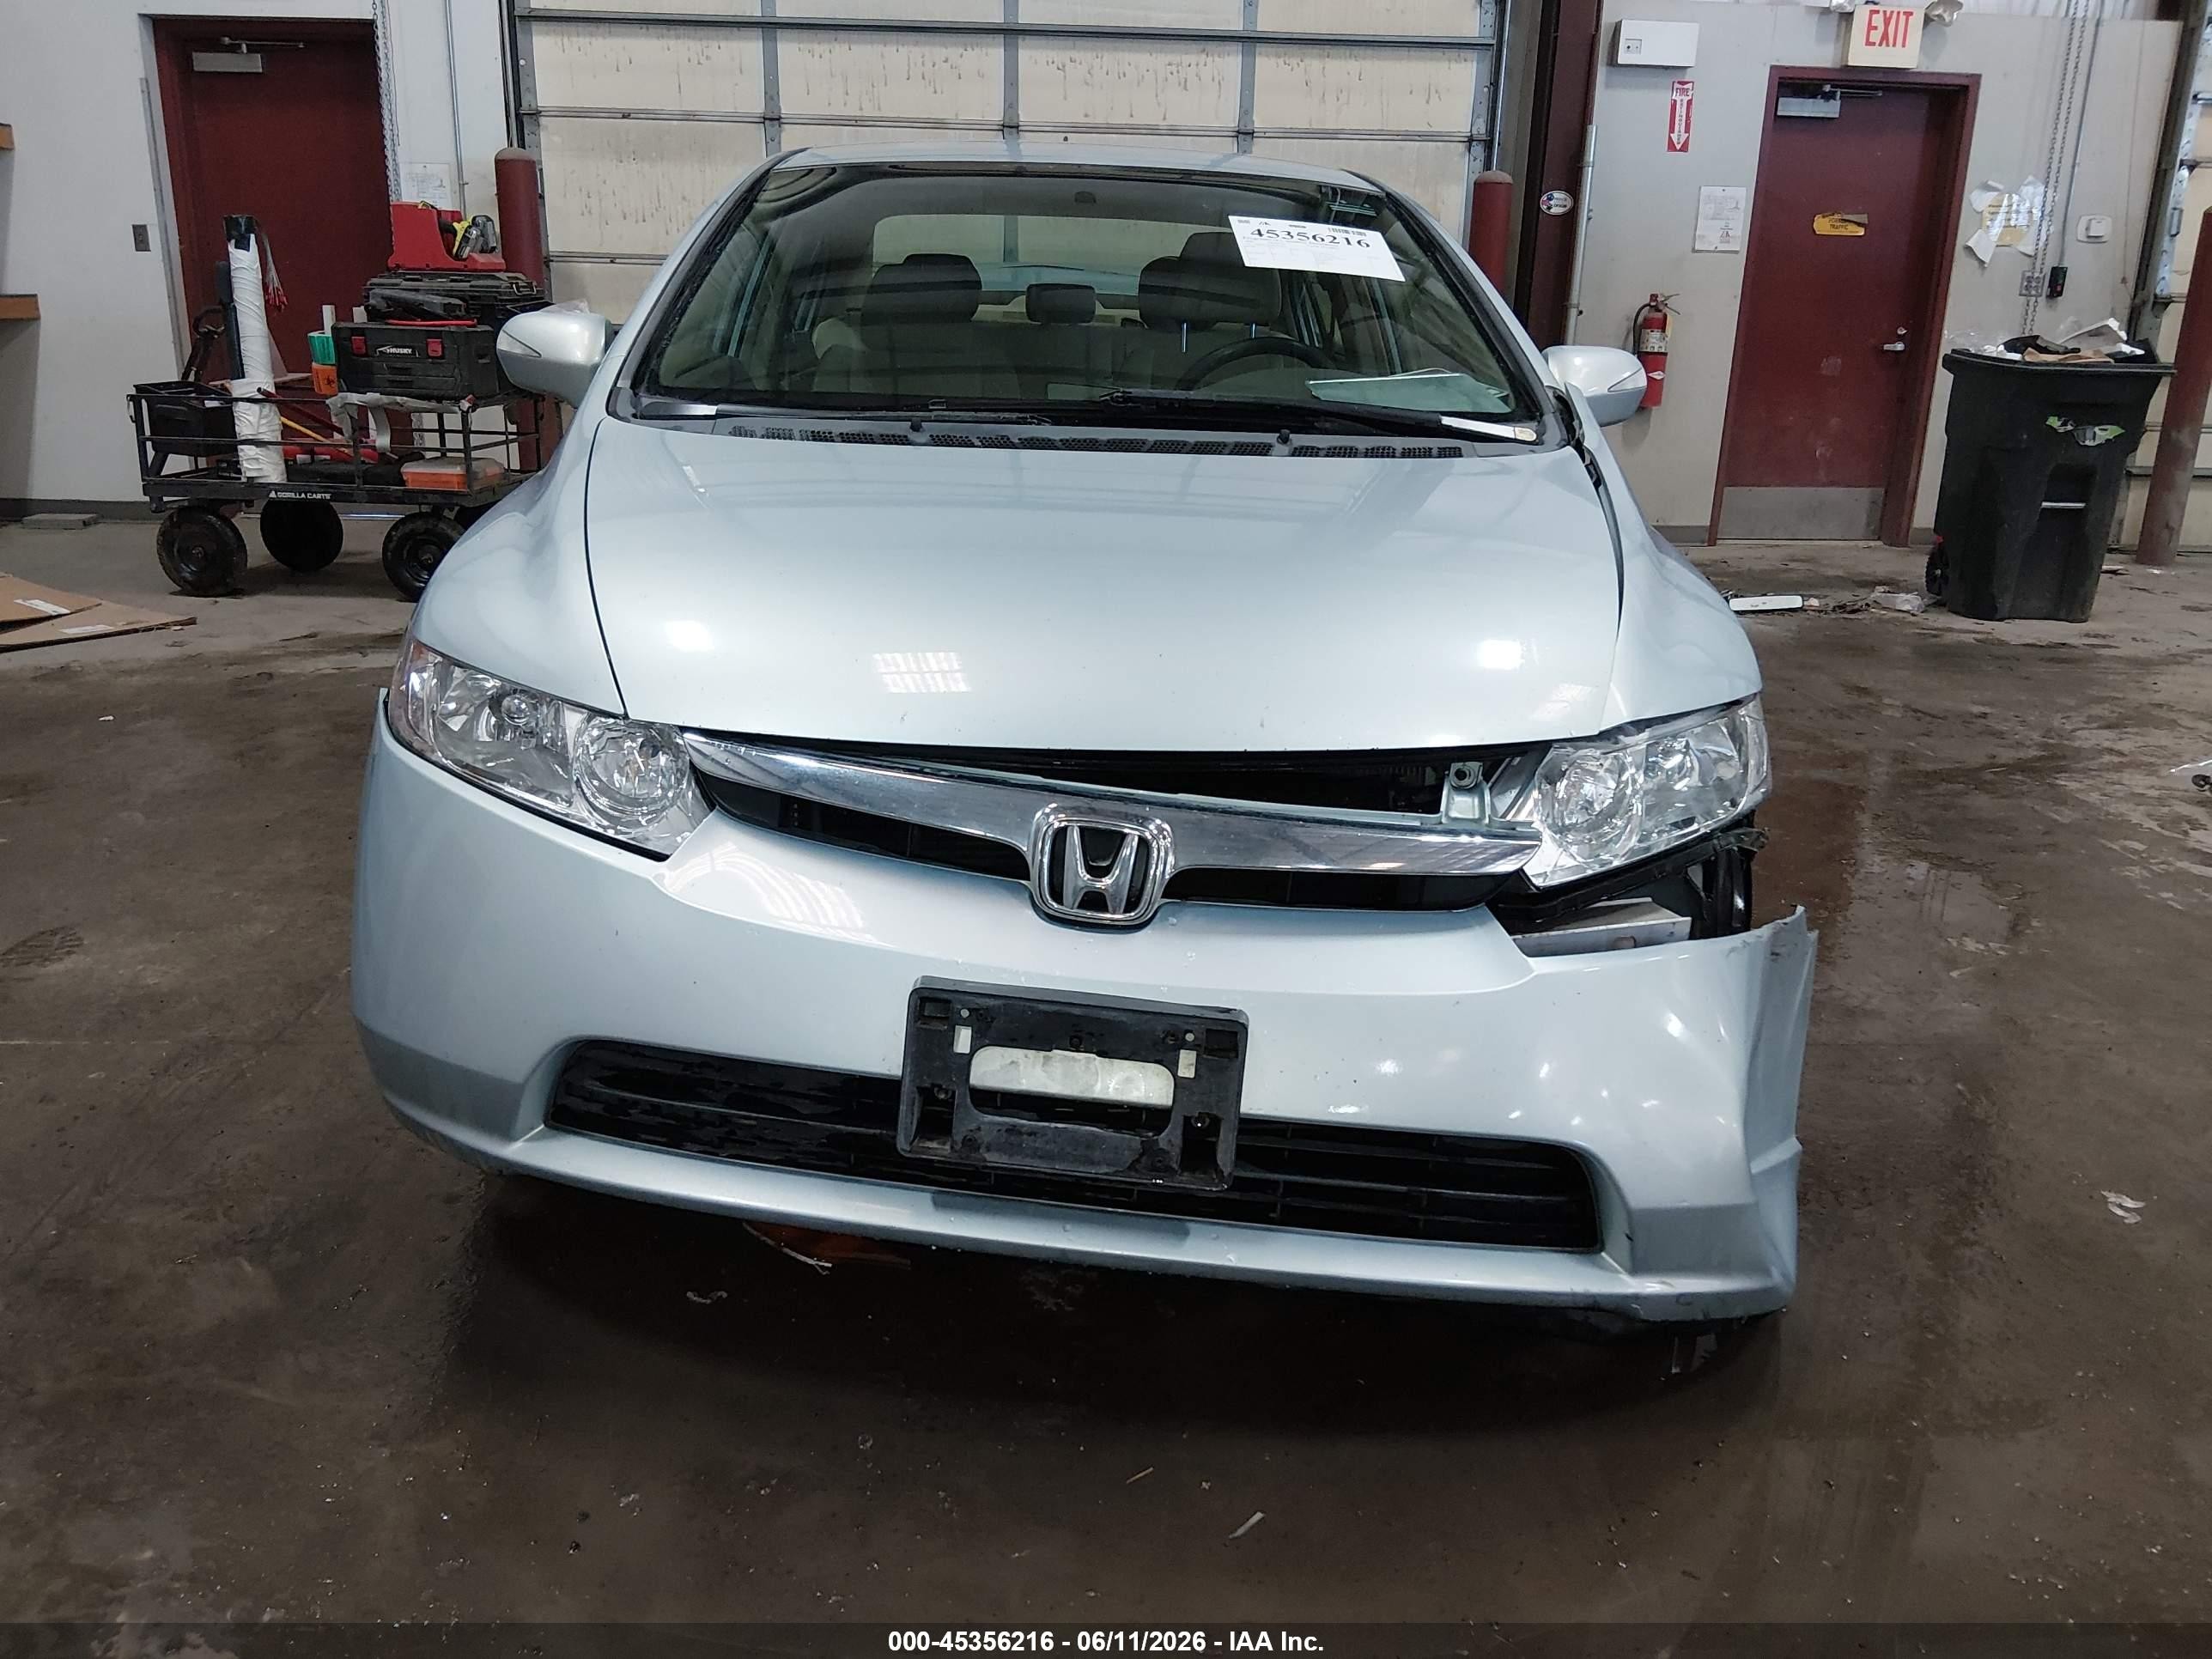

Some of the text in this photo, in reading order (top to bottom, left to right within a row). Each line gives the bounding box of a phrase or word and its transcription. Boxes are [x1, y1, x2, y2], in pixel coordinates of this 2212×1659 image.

[1865, 9, 1914, 48] EXIT
[1675, 87, 1690, 97] FIRE
[1250, 228, 1370, 249] 45356216
